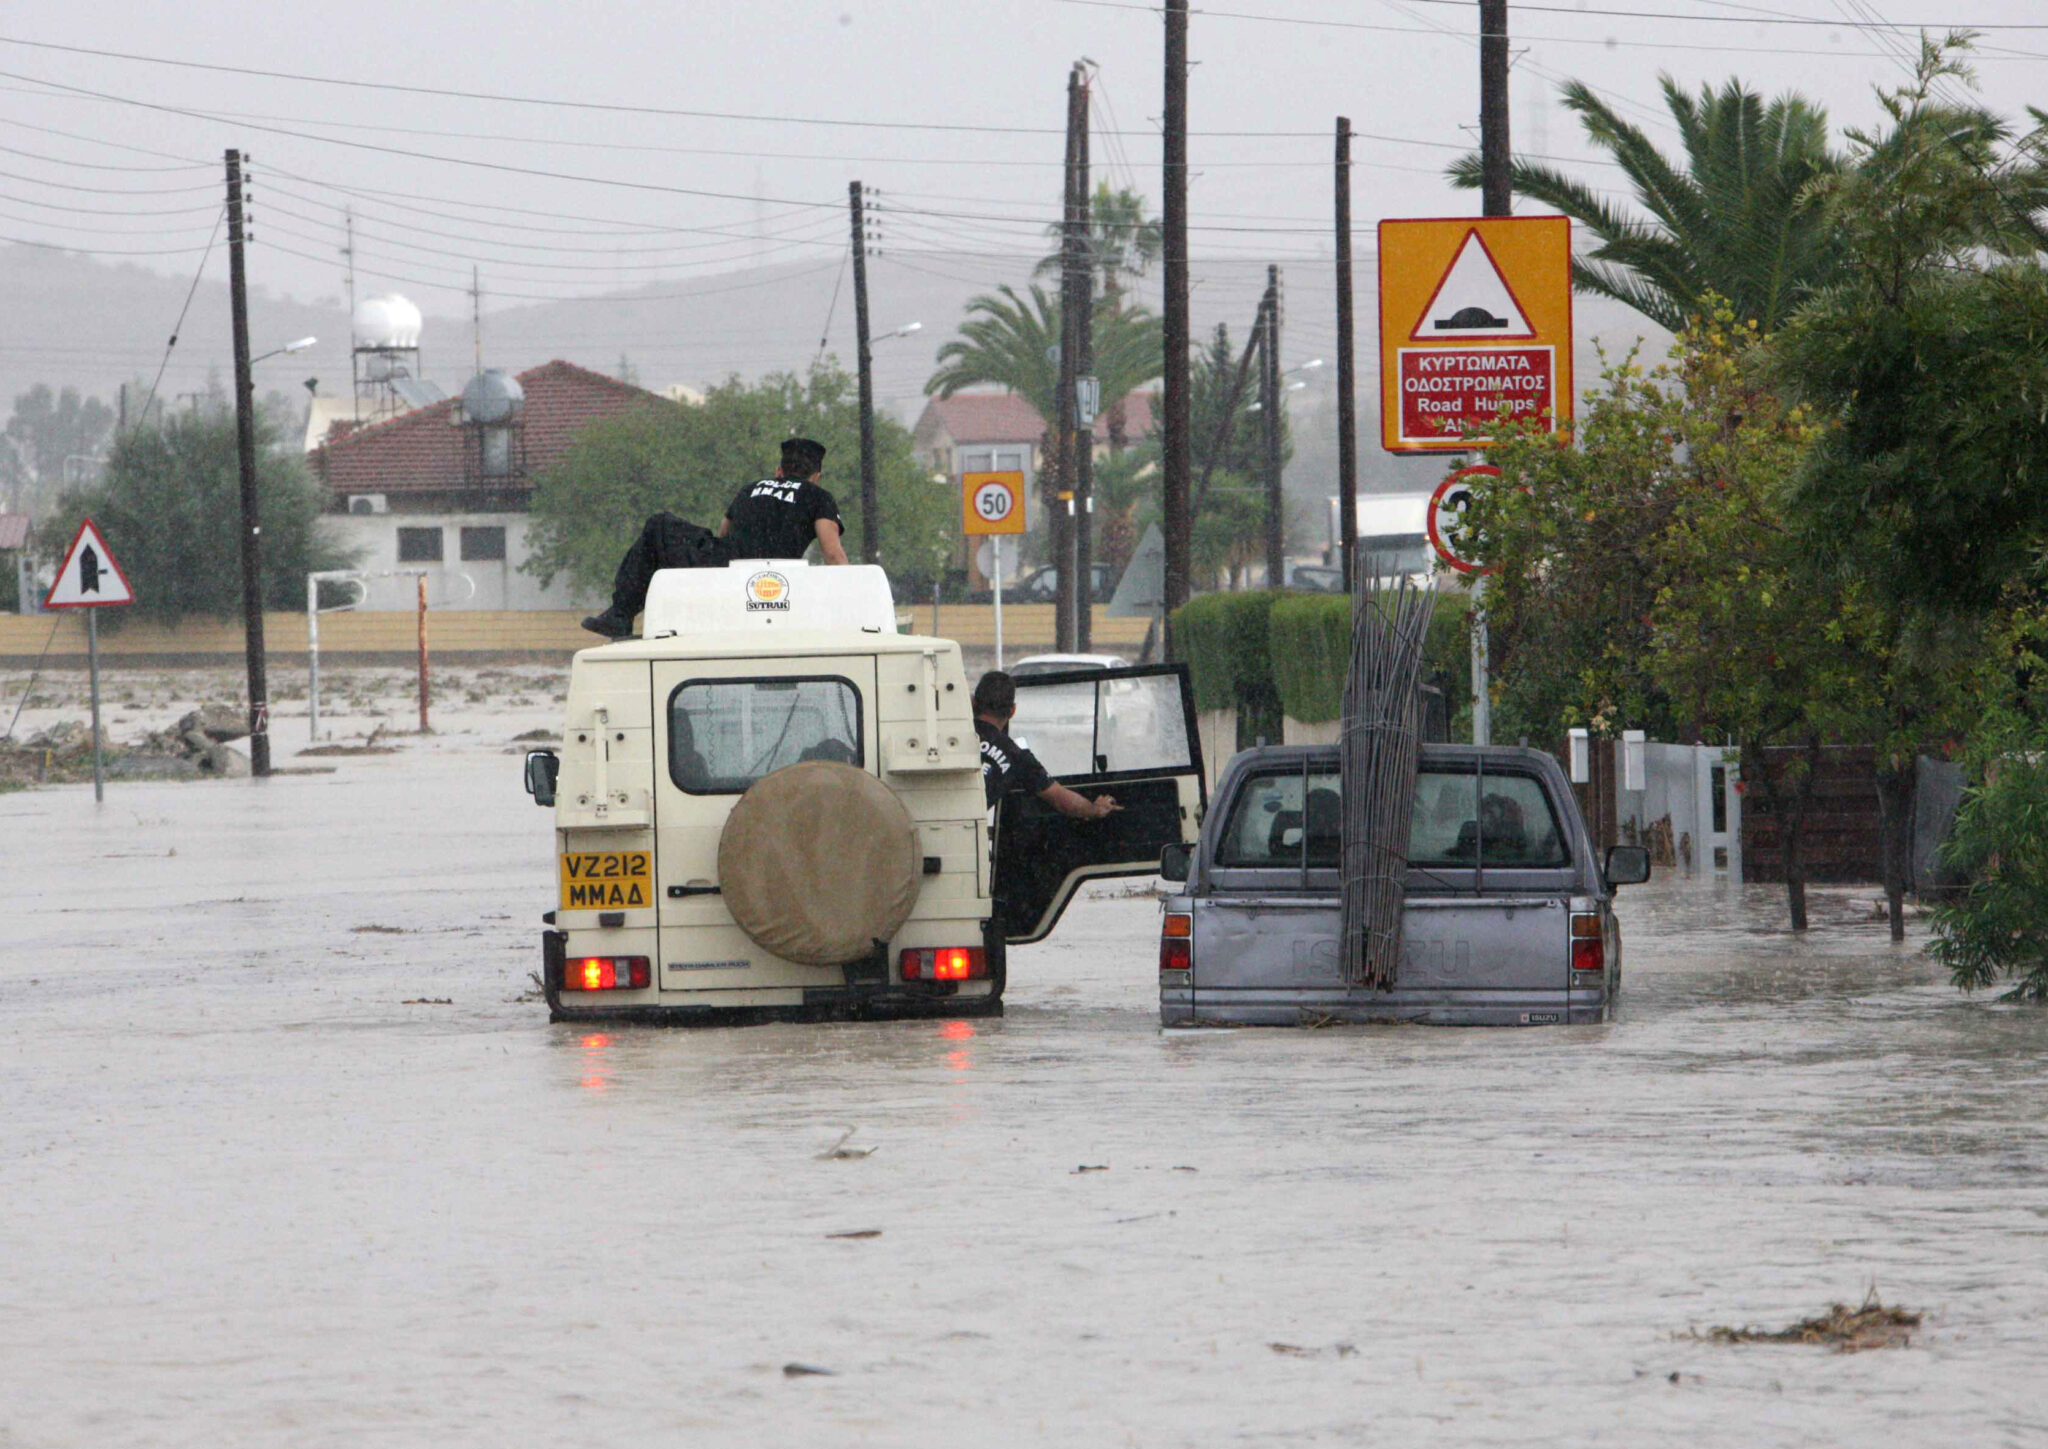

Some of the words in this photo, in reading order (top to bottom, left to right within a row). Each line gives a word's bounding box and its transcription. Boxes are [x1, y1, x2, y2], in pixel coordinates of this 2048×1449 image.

[1419, 356, 1530, 371] ΚΥΡΤΩΜΑΤΑ
[1405, 375, 1546, 392] ΟΔΟΣΤΡΩΜΑΤΟΣ
[1418, 398, 1462, 412] Road
[1475, 396, 1534, 413] Humps
[983, 493, 1006, 515] 50
[748, 601, 788, 610] SUTRAK
[566, 855, 647, 877] VZ212
[570, 883, 644, 906] ΜΜΑΔ
